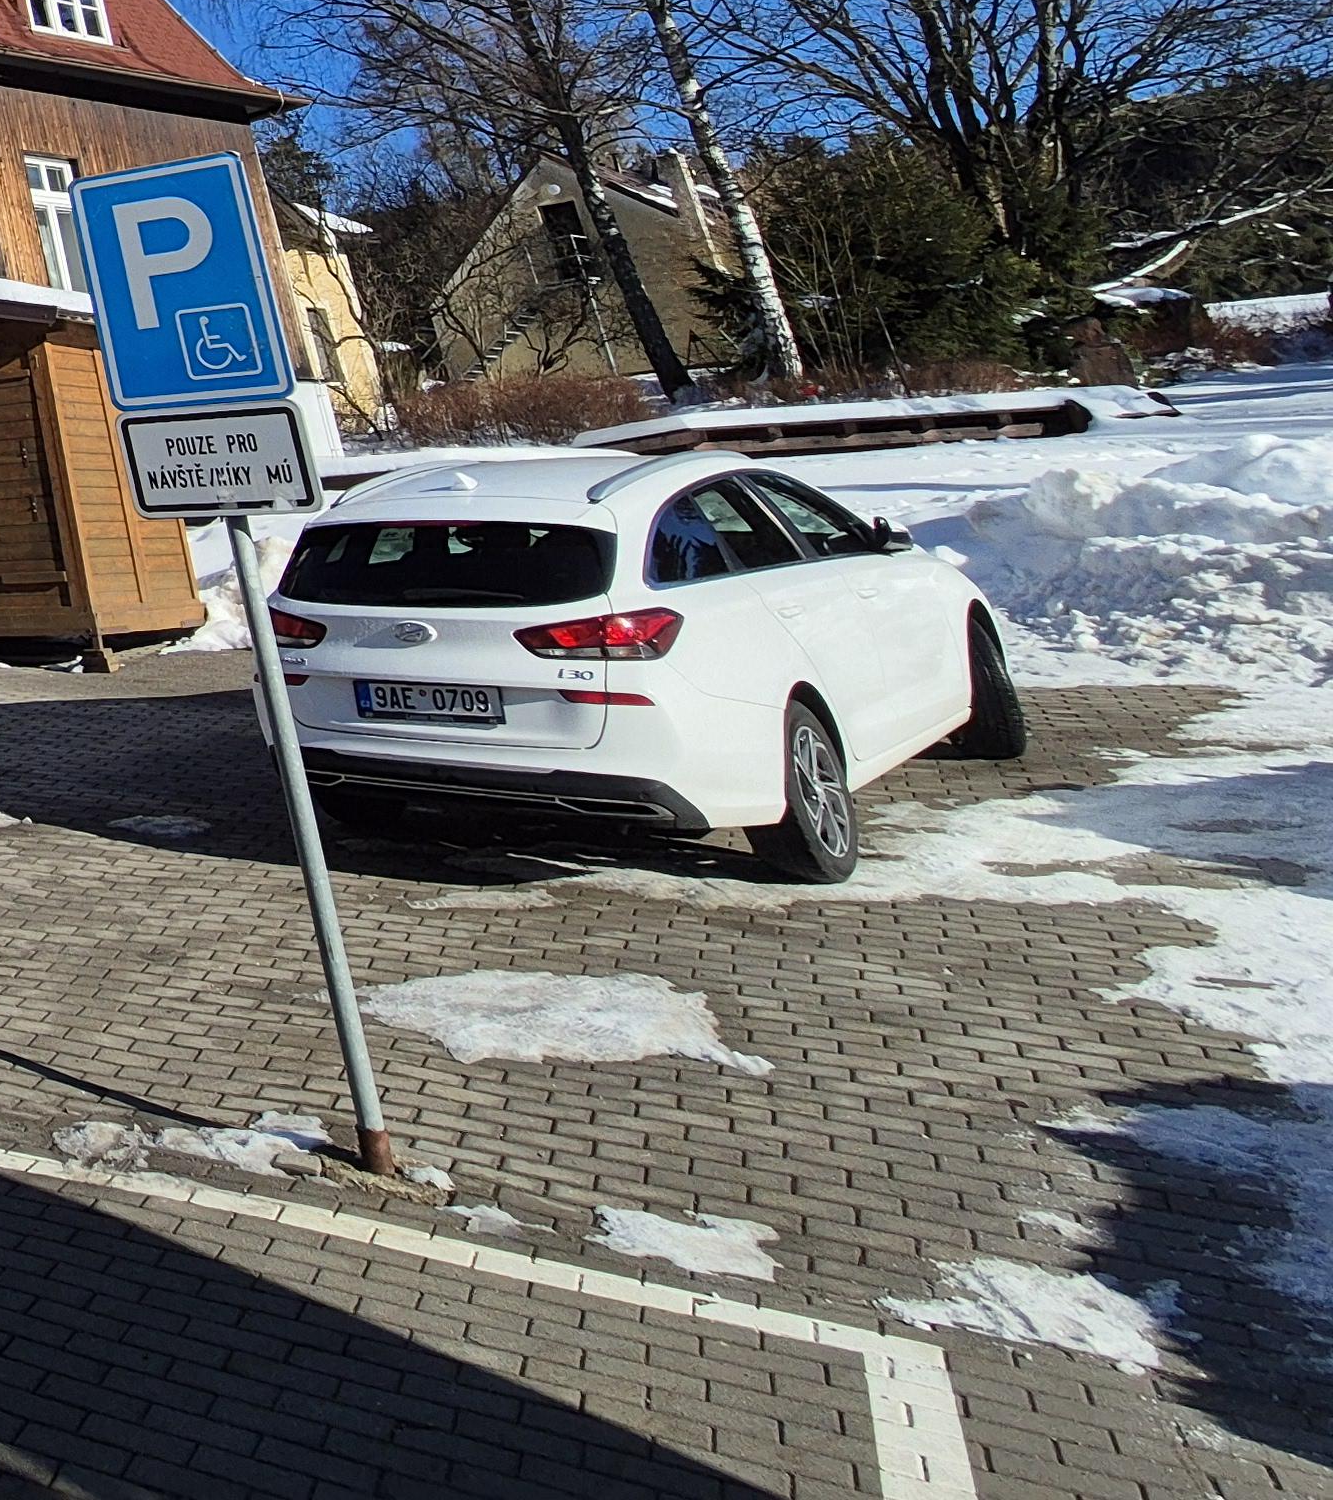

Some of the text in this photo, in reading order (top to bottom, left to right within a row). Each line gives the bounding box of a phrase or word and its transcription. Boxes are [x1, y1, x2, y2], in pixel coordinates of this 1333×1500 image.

[112, 196, 213, 330] P
[165, 433, 258, 457] POUZE PRO
[265, 458, 294, 484] MÚ
[374, 686, 490, 713] 9AE 0709
